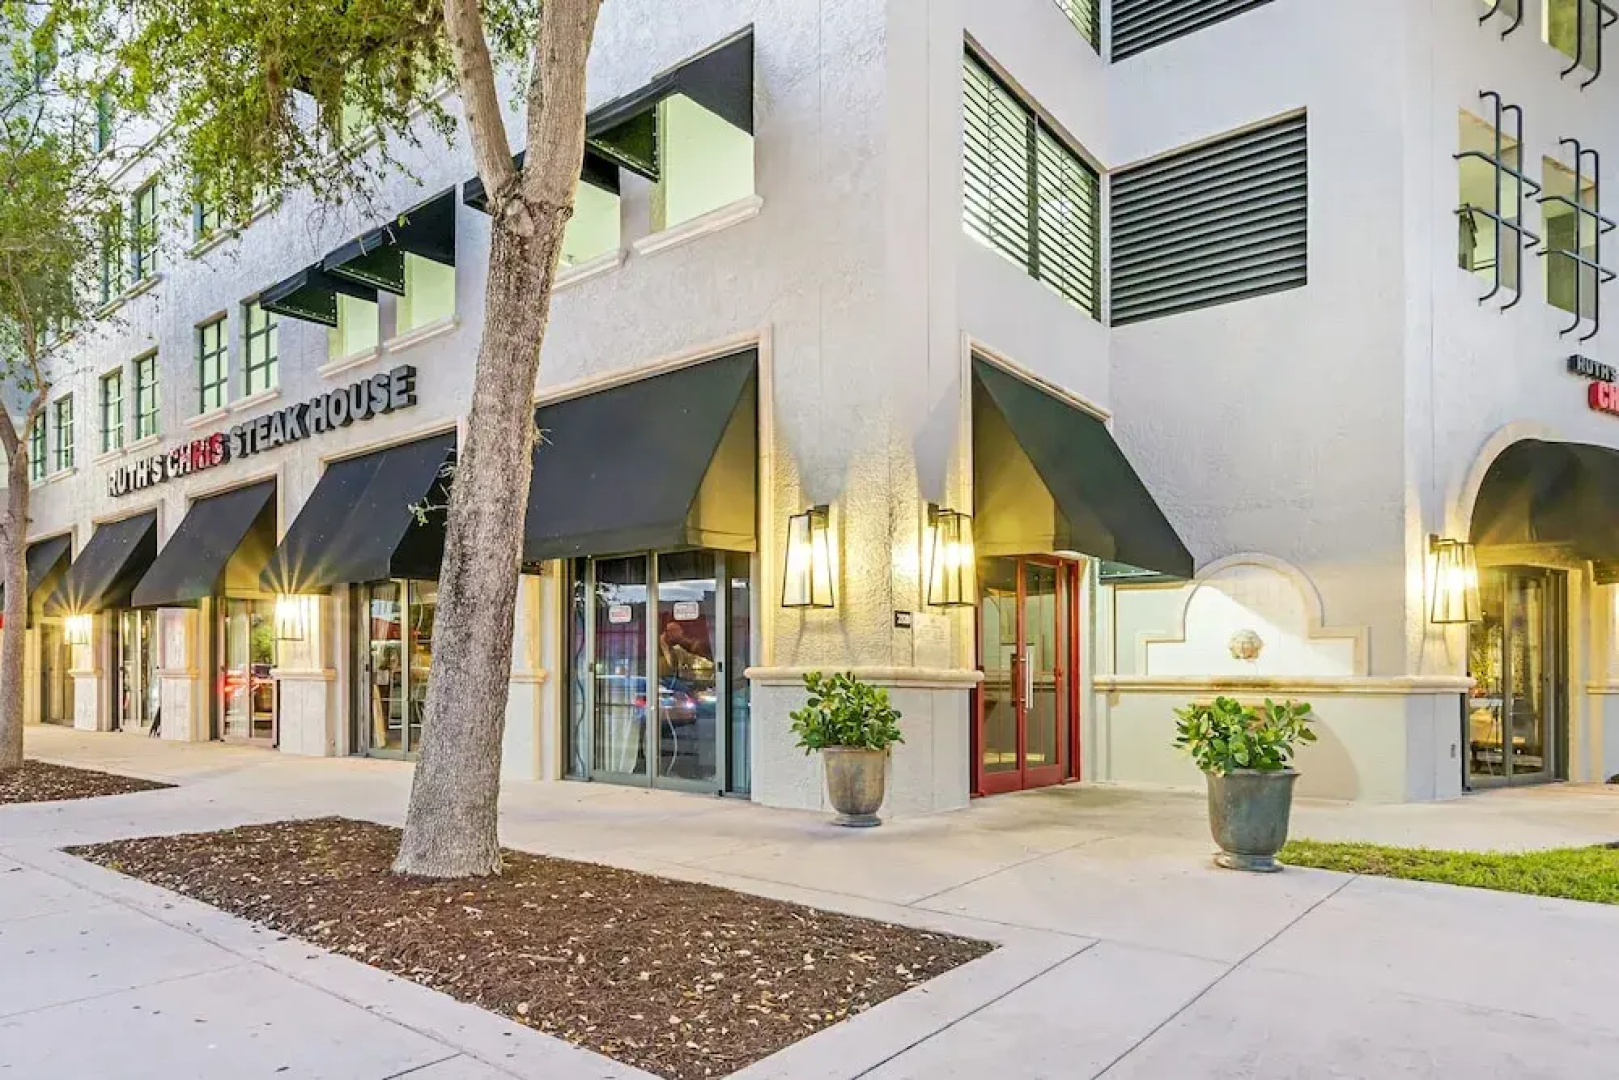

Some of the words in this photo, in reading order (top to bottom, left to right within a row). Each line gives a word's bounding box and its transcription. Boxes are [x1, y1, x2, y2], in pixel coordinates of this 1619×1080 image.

[107, 453, 167, 497] RUTH'S
[166, 431, 226, 478] CHRIS
[229, 405, 309, 458] STEAK
[308, 364, 415, 433] HOUSE
